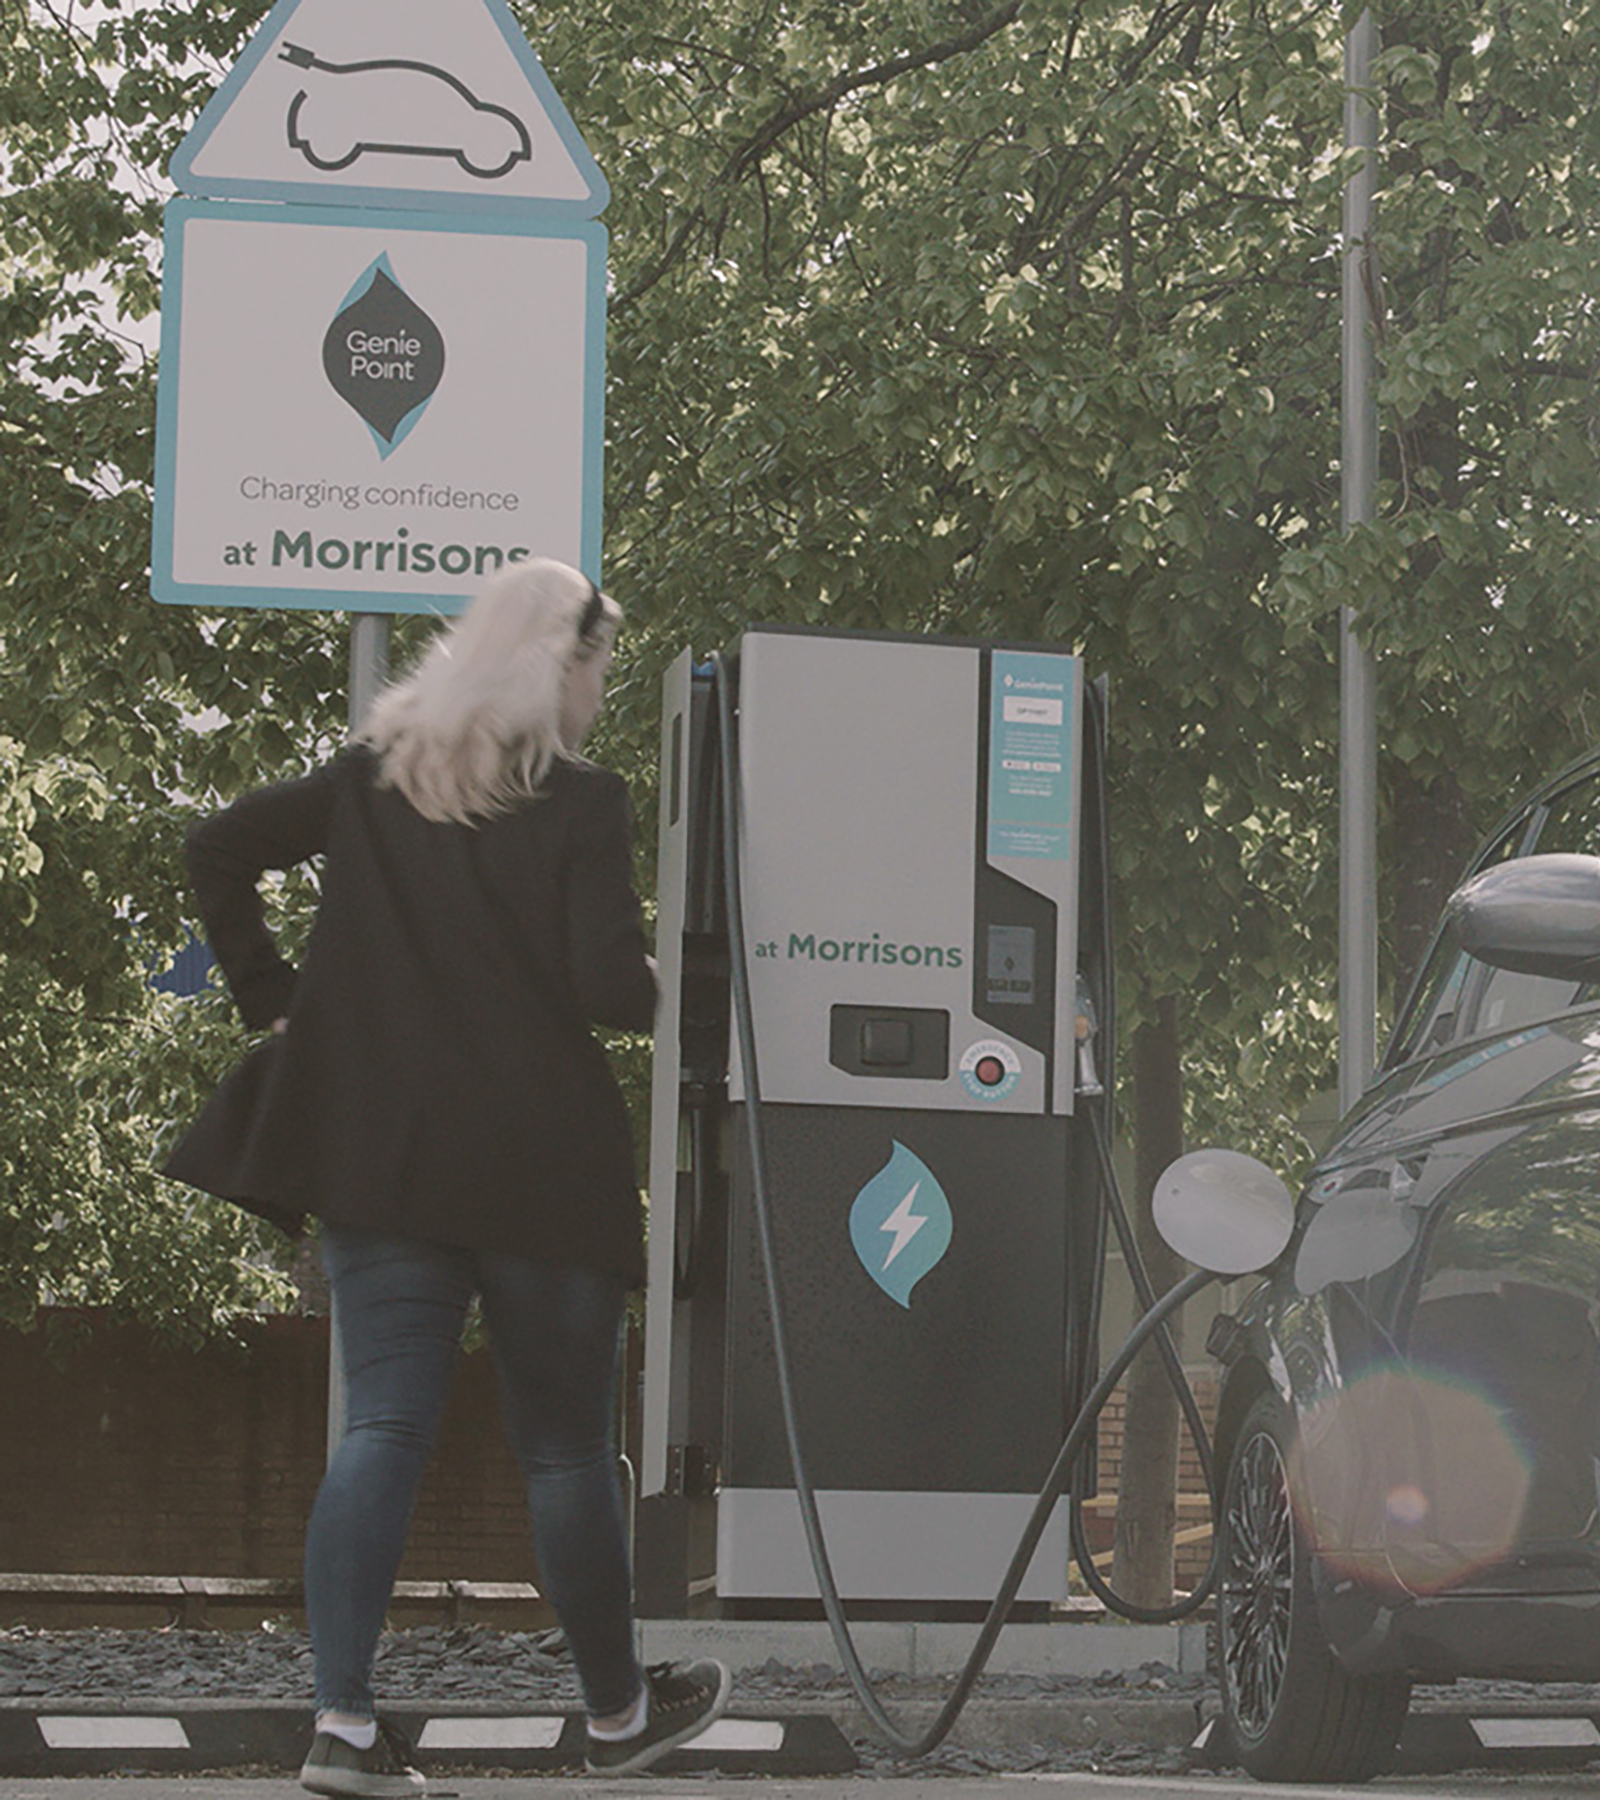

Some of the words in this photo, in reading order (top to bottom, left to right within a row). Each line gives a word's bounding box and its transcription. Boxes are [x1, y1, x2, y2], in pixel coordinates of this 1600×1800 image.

[346, 329, 421, 356] Genie
[351, 355, 415, 381] Point
[240, 476, 360, 510] Charging
[364, 483, 520, 512] confidence
[223, 541, 257, 567] at
[755, 940, 778, 959] at
[787, 933, 963, 969] Morrisons
